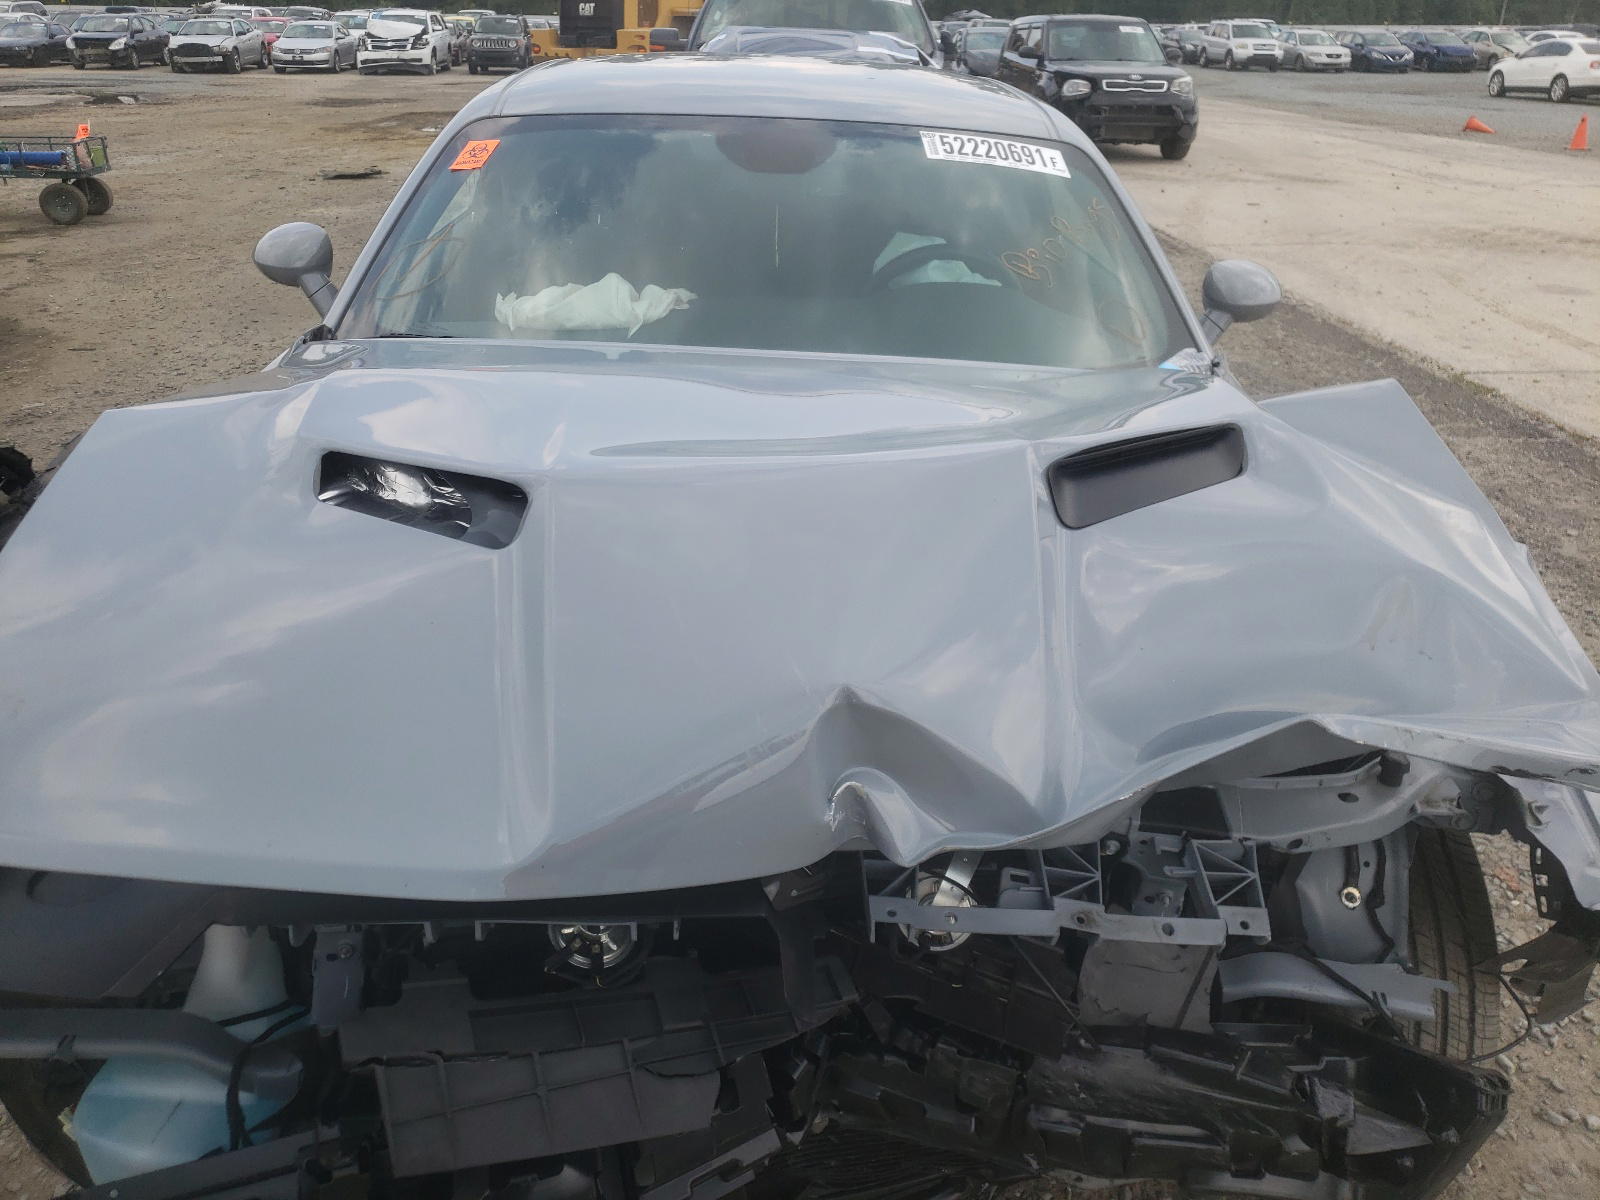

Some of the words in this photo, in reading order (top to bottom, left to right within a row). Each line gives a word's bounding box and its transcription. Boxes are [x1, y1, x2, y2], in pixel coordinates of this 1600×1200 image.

[579, 2, 596, 16] CAT
[938, 134, 1048, 168] 52220691
[1050, 156, 1058, 168] F
